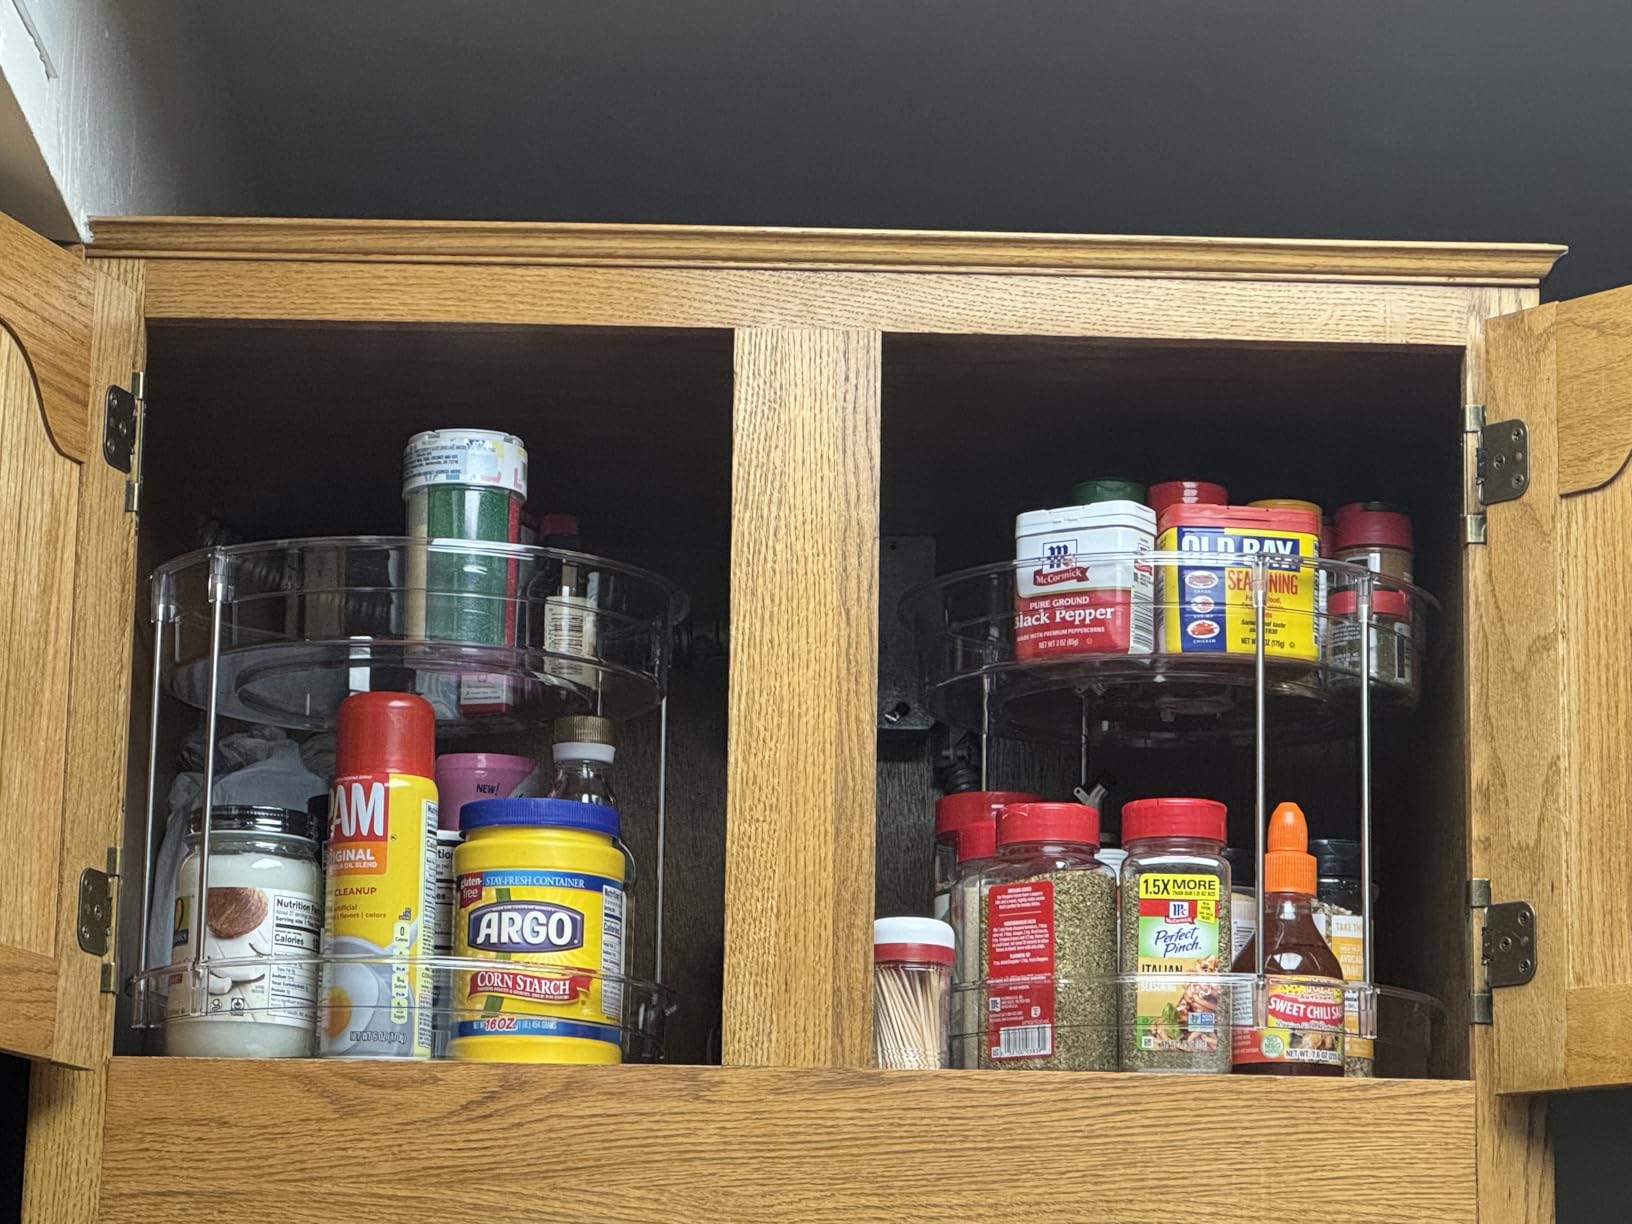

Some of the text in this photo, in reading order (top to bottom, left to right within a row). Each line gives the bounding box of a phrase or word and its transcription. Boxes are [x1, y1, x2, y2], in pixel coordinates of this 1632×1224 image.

[1035, 569, 1082, 585] McCormick
[1228, 570, 1299, 595] SEANING
[1029, 596, 1090, 610] PURE GROUND
[1055, 607, 1115, 625] Pepper
[476, 782, 501, 797] NEW!
[485, 875, 586, 889] STAY-FRESH CONTAINER
[1143, 879, 1217, 896] 1.5X MORE
[463, 888, 478, 899] free
[276, 899, 311, 913] Nutrition
[399, 926, 405, 937] 0
[476, 911, 573, 946] ARGO
[1154, 926, 1200, 945] Perfect
[274, 933, 304, 946] Calories
[477, 970, 570, 995] CORN STARCH
[1268, 997, 1307, 1017] SWEET
[1307, 1005, 1331, 1020] CHILI
